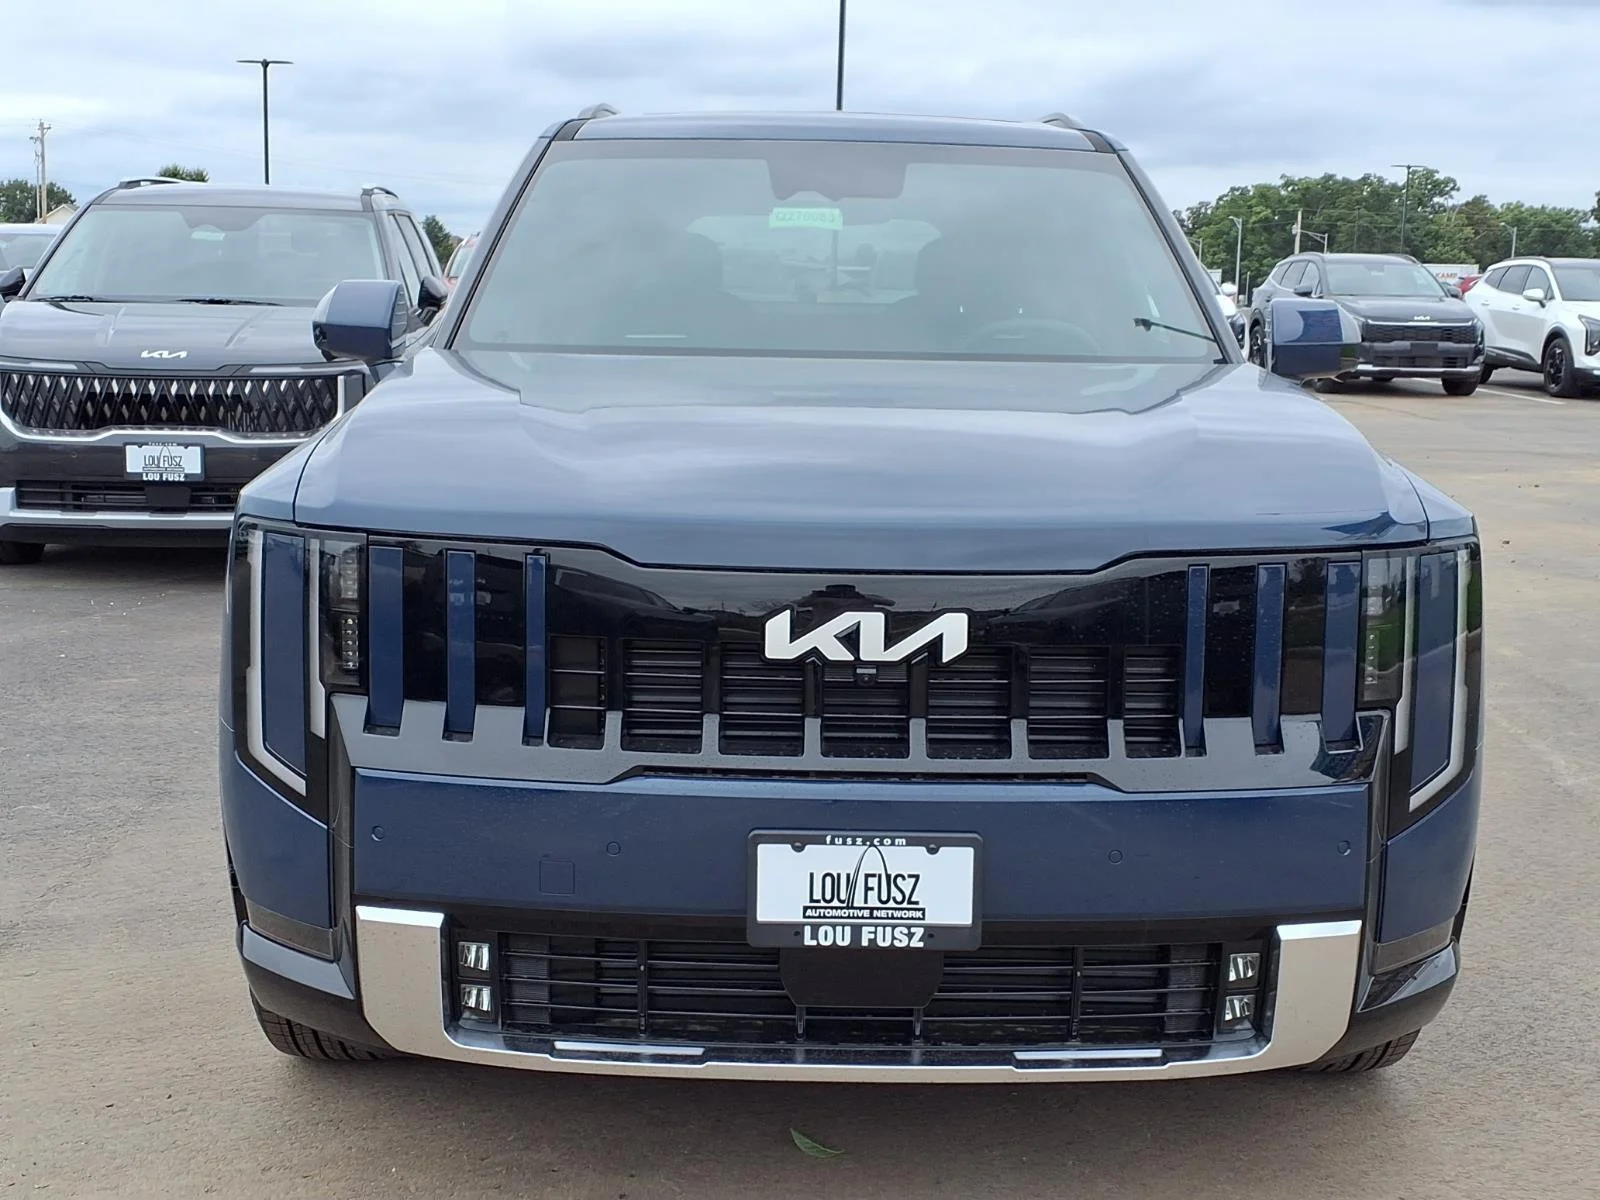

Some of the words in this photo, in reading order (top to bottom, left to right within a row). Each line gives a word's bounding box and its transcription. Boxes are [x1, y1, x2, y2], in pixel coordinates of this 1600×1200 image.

[143, 473, 160, 481] LOU
[163, 473, 185, 481] FUSZ
[765, 609, 968, 663] KIA
[826, 835, 906, 846] fusz.com
[809, 872, 851, 904] LOU
[864, 874, 920, 905] FUSZ
[805, 909, 870, 918] AUTOMOTIVE
[873, 911, 923, 919] NETWORK
[804, 925, 851, 946] LOU
[861, 927, 924, 947] FUSZ
